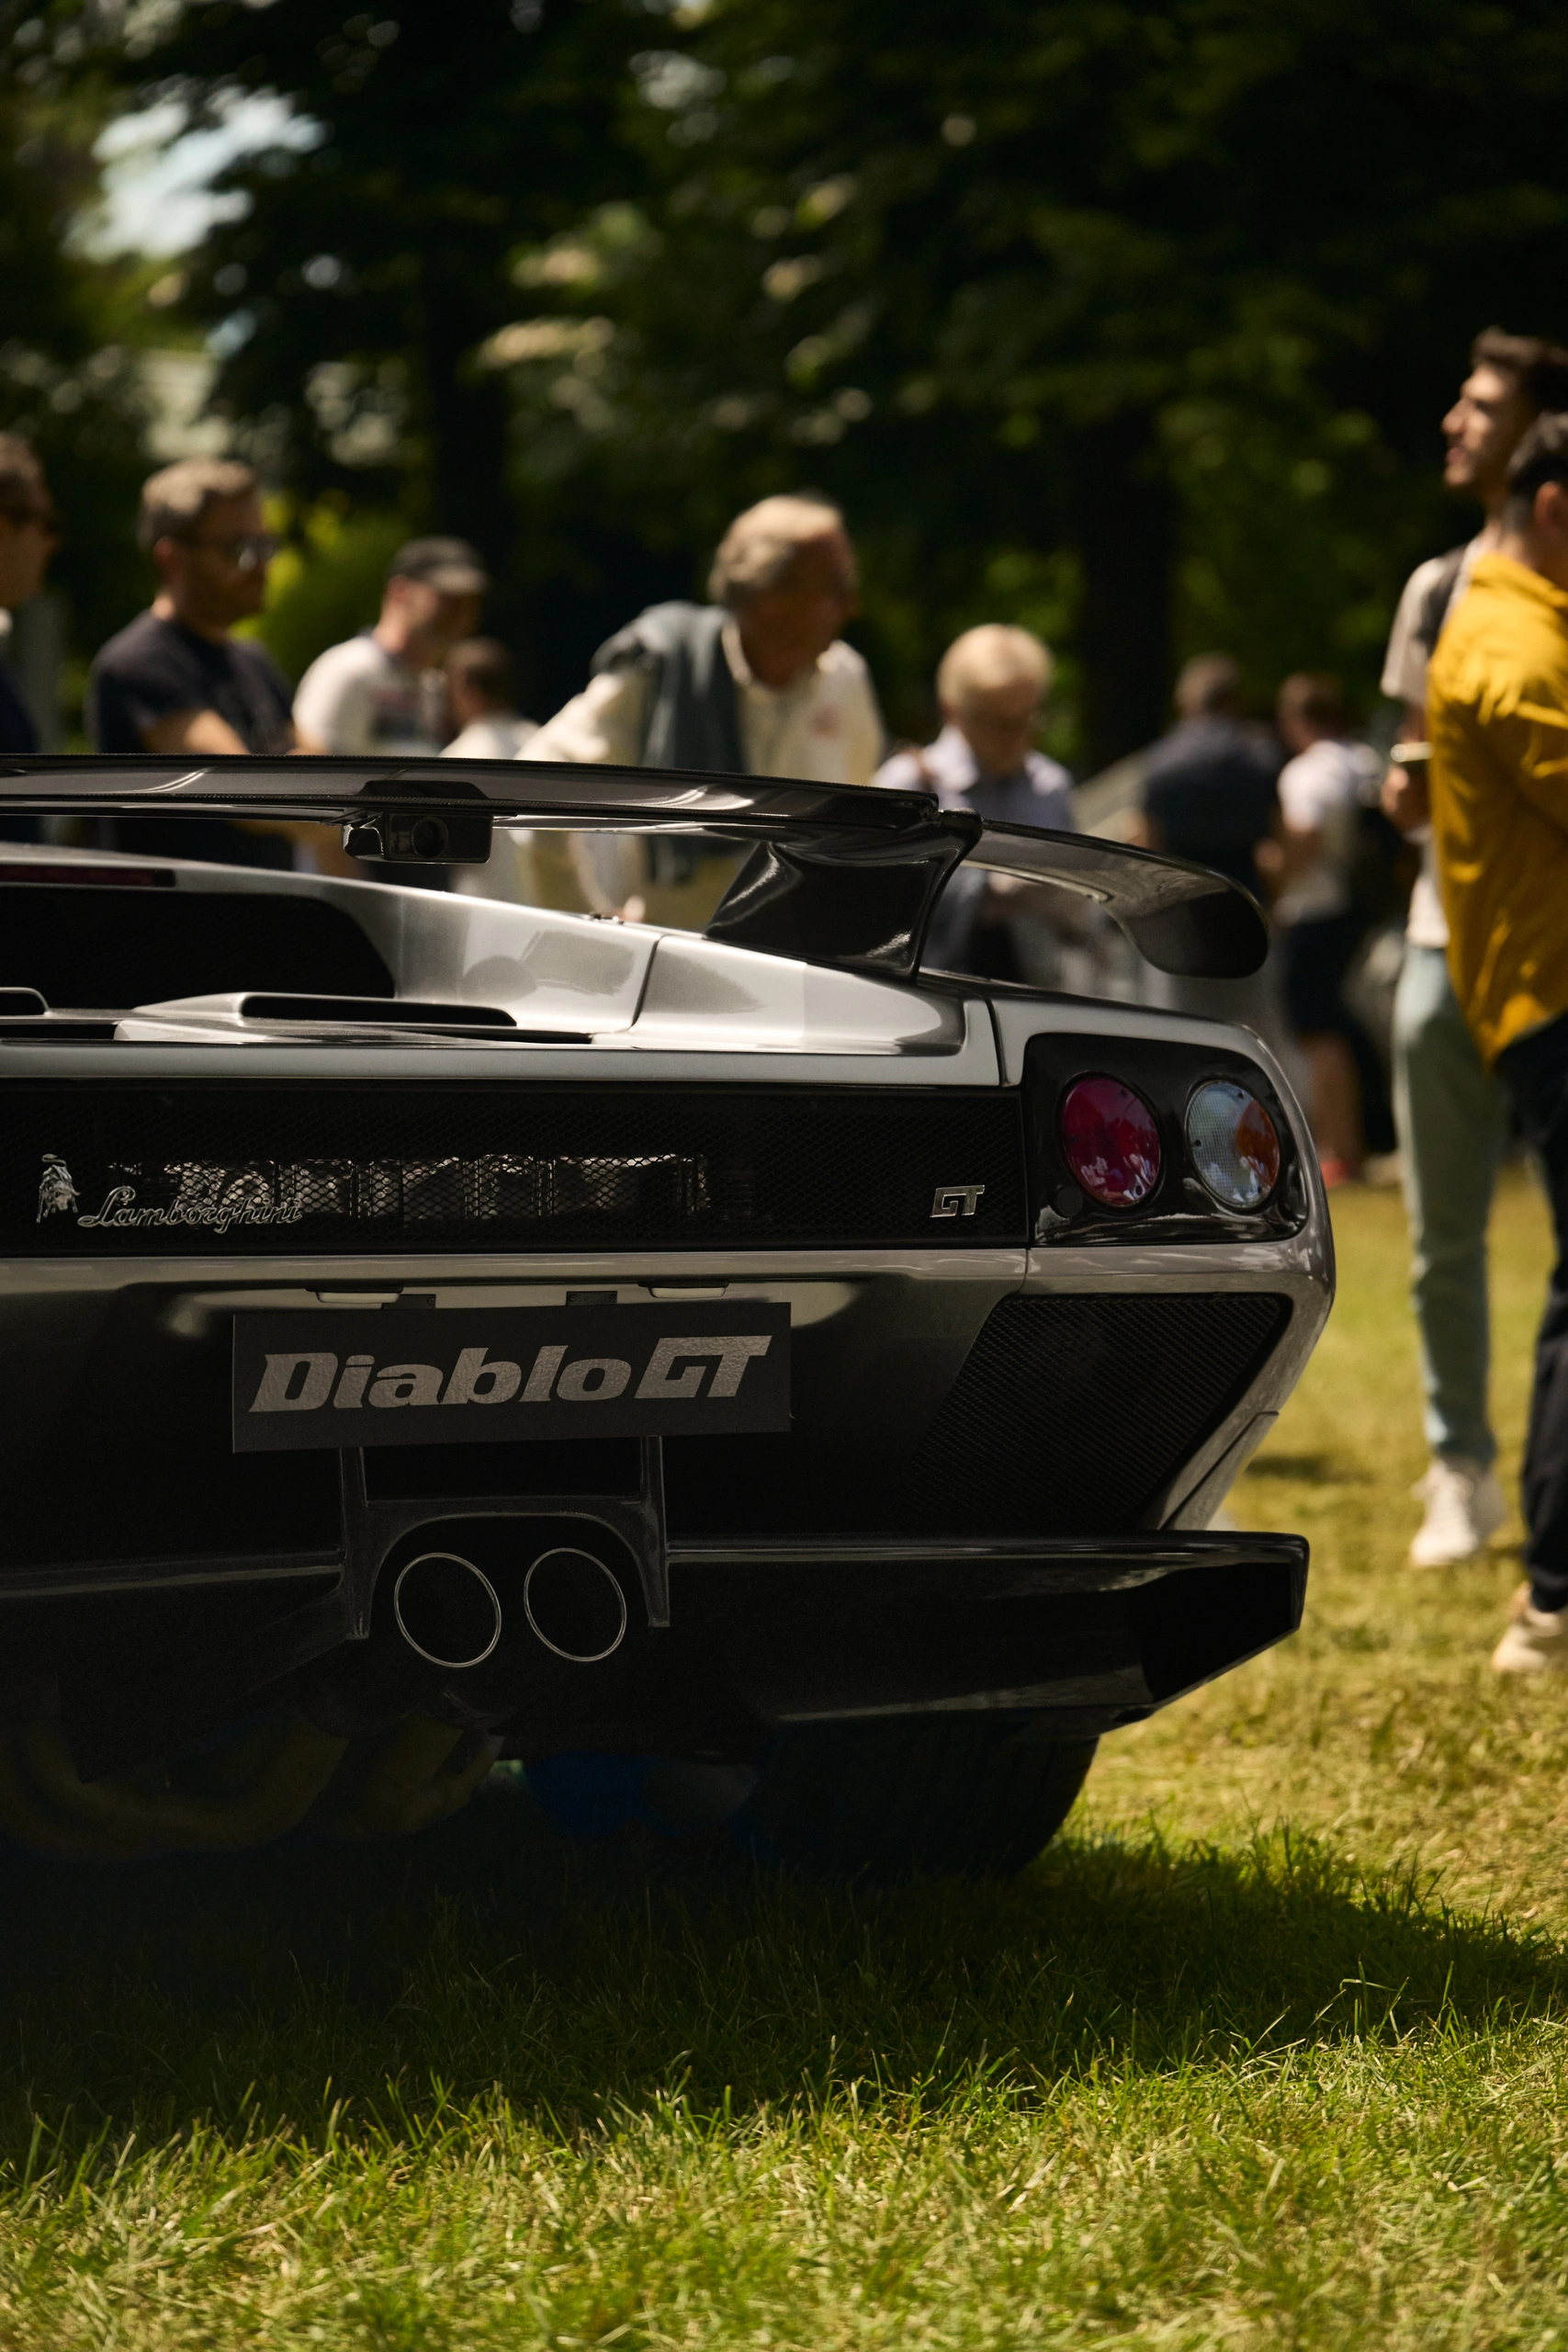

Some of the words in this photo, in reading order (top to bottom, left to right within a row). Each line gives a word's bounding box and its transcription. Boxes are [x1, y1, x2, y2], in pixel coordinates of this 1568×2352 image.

[77, 1185, 302, 1234] Lamborghini
[930, 1184, 986, 1218] GT
[248, 1344, 632, 1413] Diablo
[634, 1335, 773, 1400] GT
